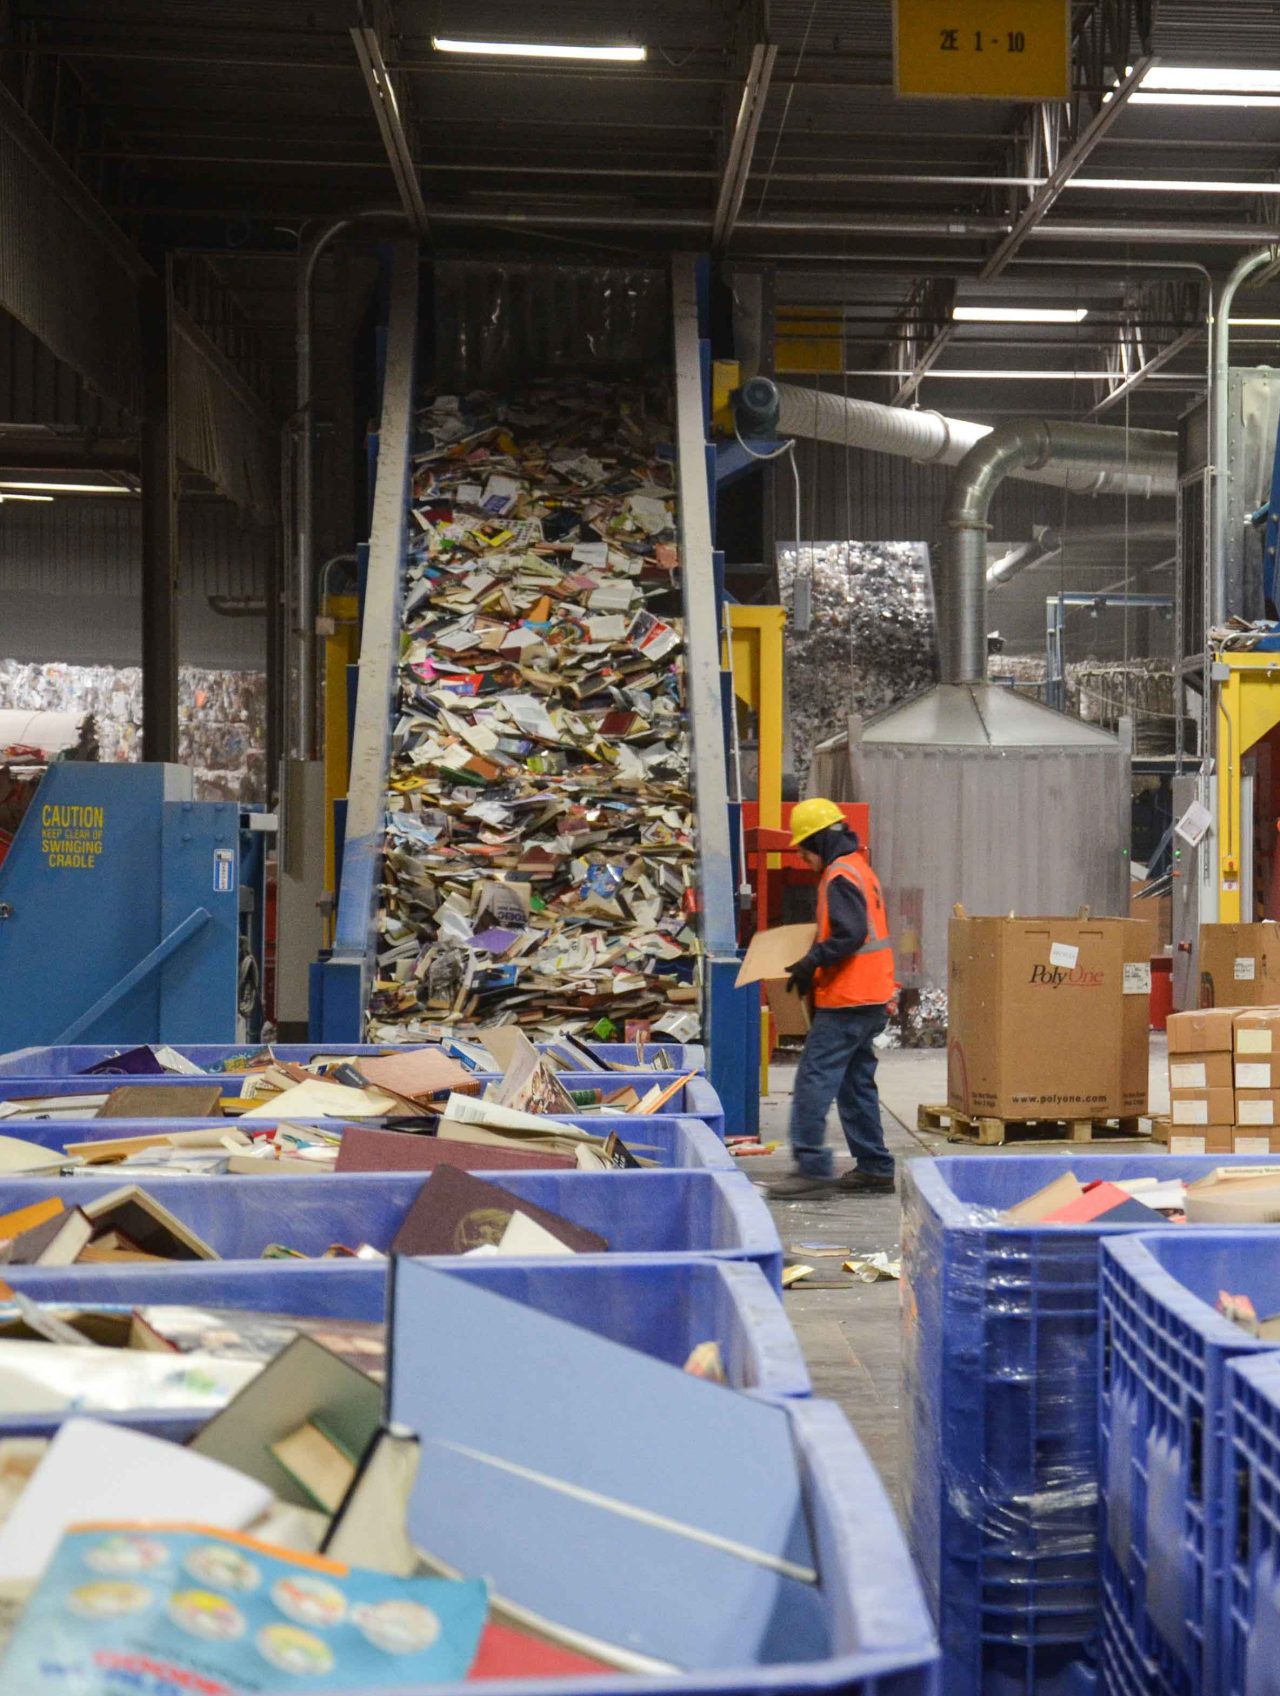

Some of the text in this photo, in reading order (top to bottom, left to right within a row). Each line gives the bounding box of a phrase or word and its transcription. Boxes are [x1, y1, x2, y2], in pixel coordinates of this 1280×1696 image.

[940, 29, 959, 51] 2E
[974, 30, 983, 52] 1
[1007, 31, 1025, 53] 10
[42, 804, 104, 829] CAUTION
[41, 839, 103, 854] SWINGING
[49, 854, 95, 868] CRADLE
[1028, 963, 1105, 989] PolyOne
[1012, 1094, 1107, 1105] www.polyone.com
